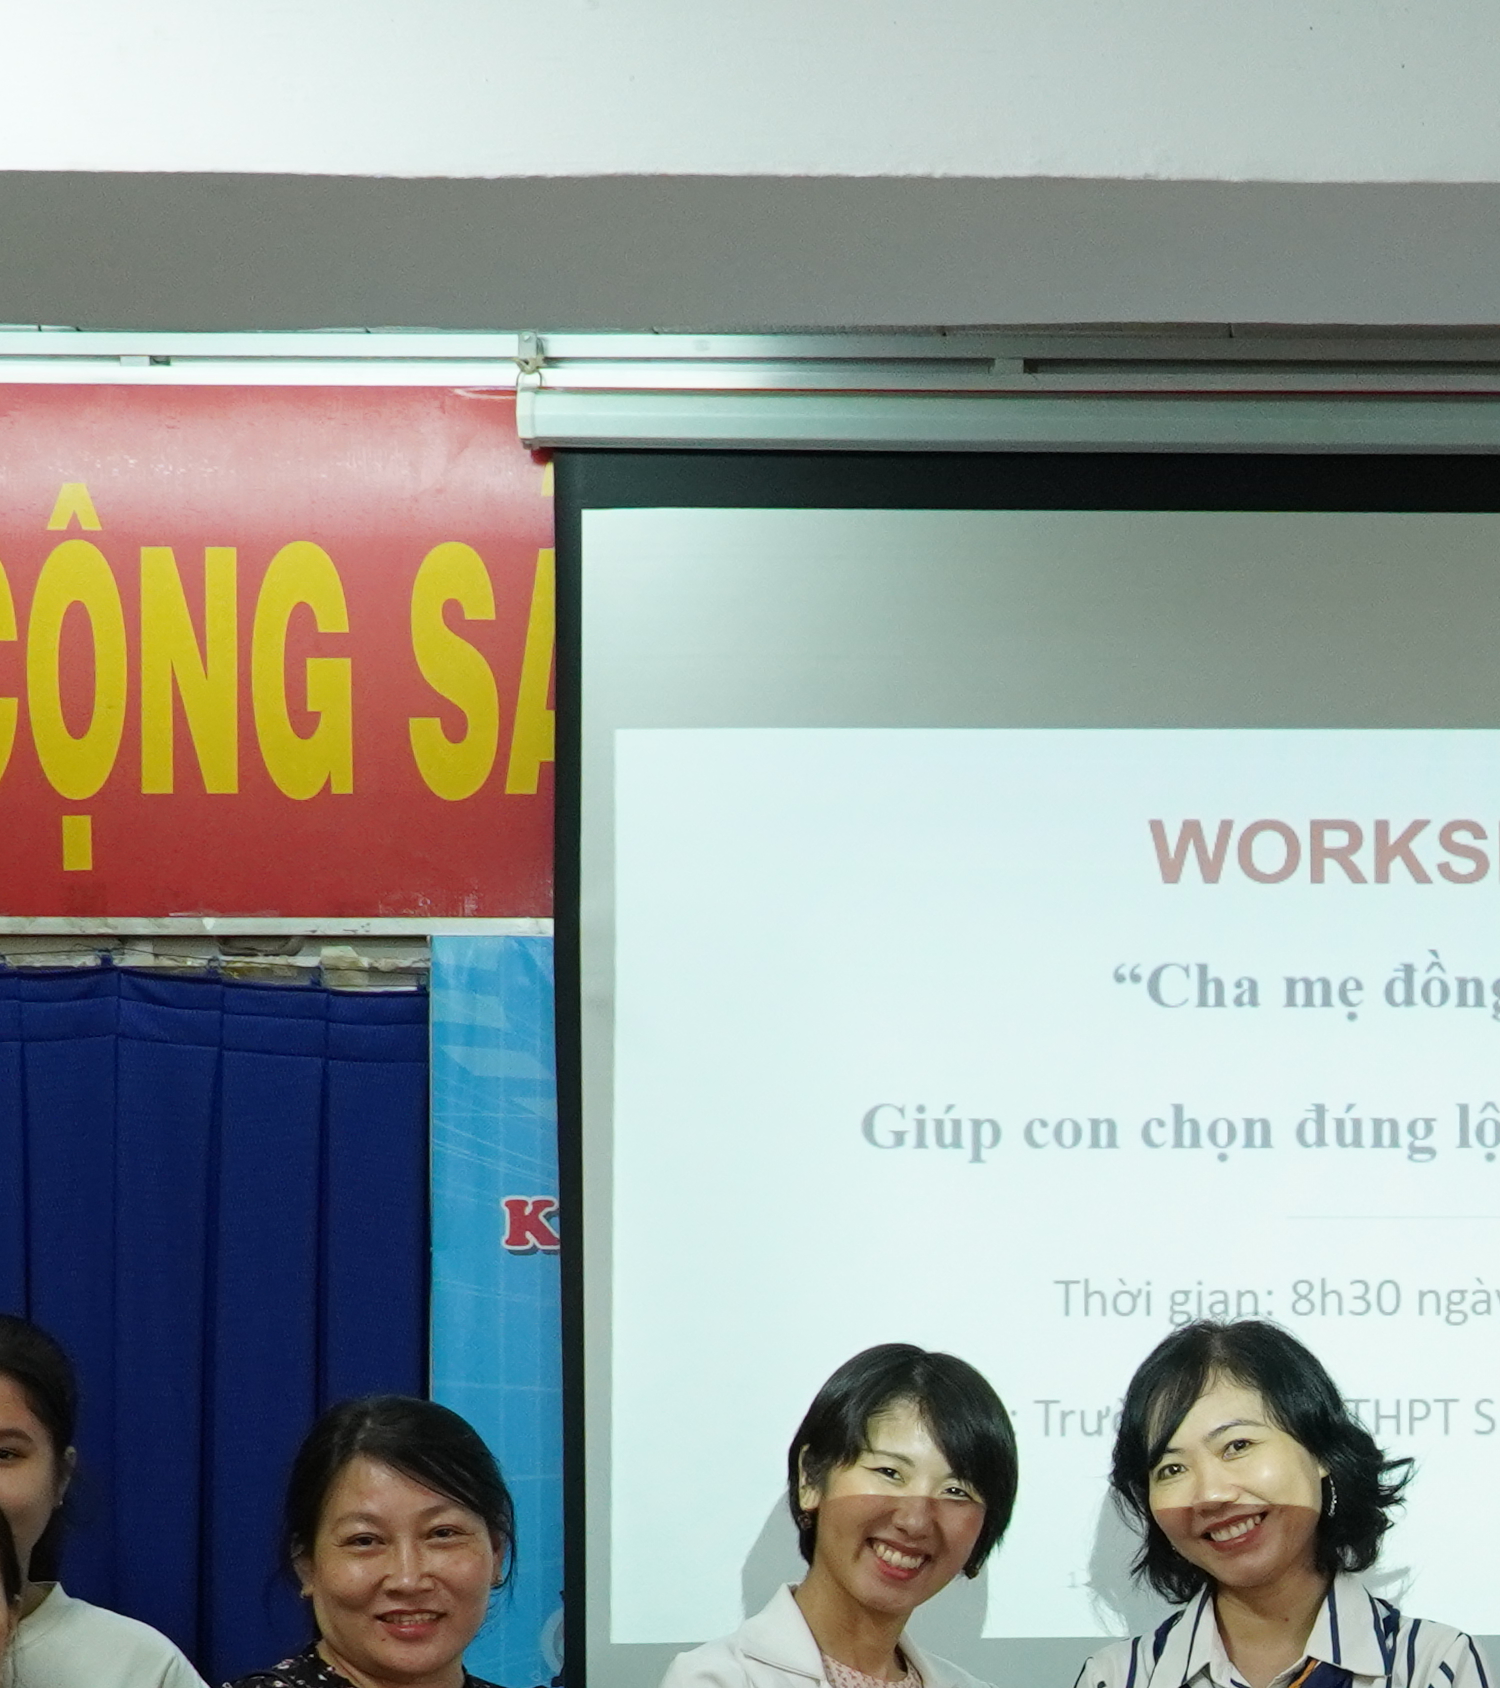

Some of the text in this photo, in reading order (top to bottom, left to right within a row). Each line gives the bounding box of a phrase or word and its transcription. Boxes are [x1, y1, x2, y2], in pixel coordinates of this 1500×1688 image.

[1112, 962, 1261, 1009] “Cha
[1283, 973, 1364, 1022] mẹ
[860, 1102, 1003, 1164] Giúp
[1022, 1117, 1121, 1150] con
[1140, 1102, 1275, 1163] chọn
[1295, 1102, 1438, 1164] đúng
[1053, 1278, 1153, 1318] Thời
[1169, 1281, 1275, 1326] gian:
[1290, 1277, 1402, 1318] 8h30
[1343, 1398, 1460, 1435] THPT
